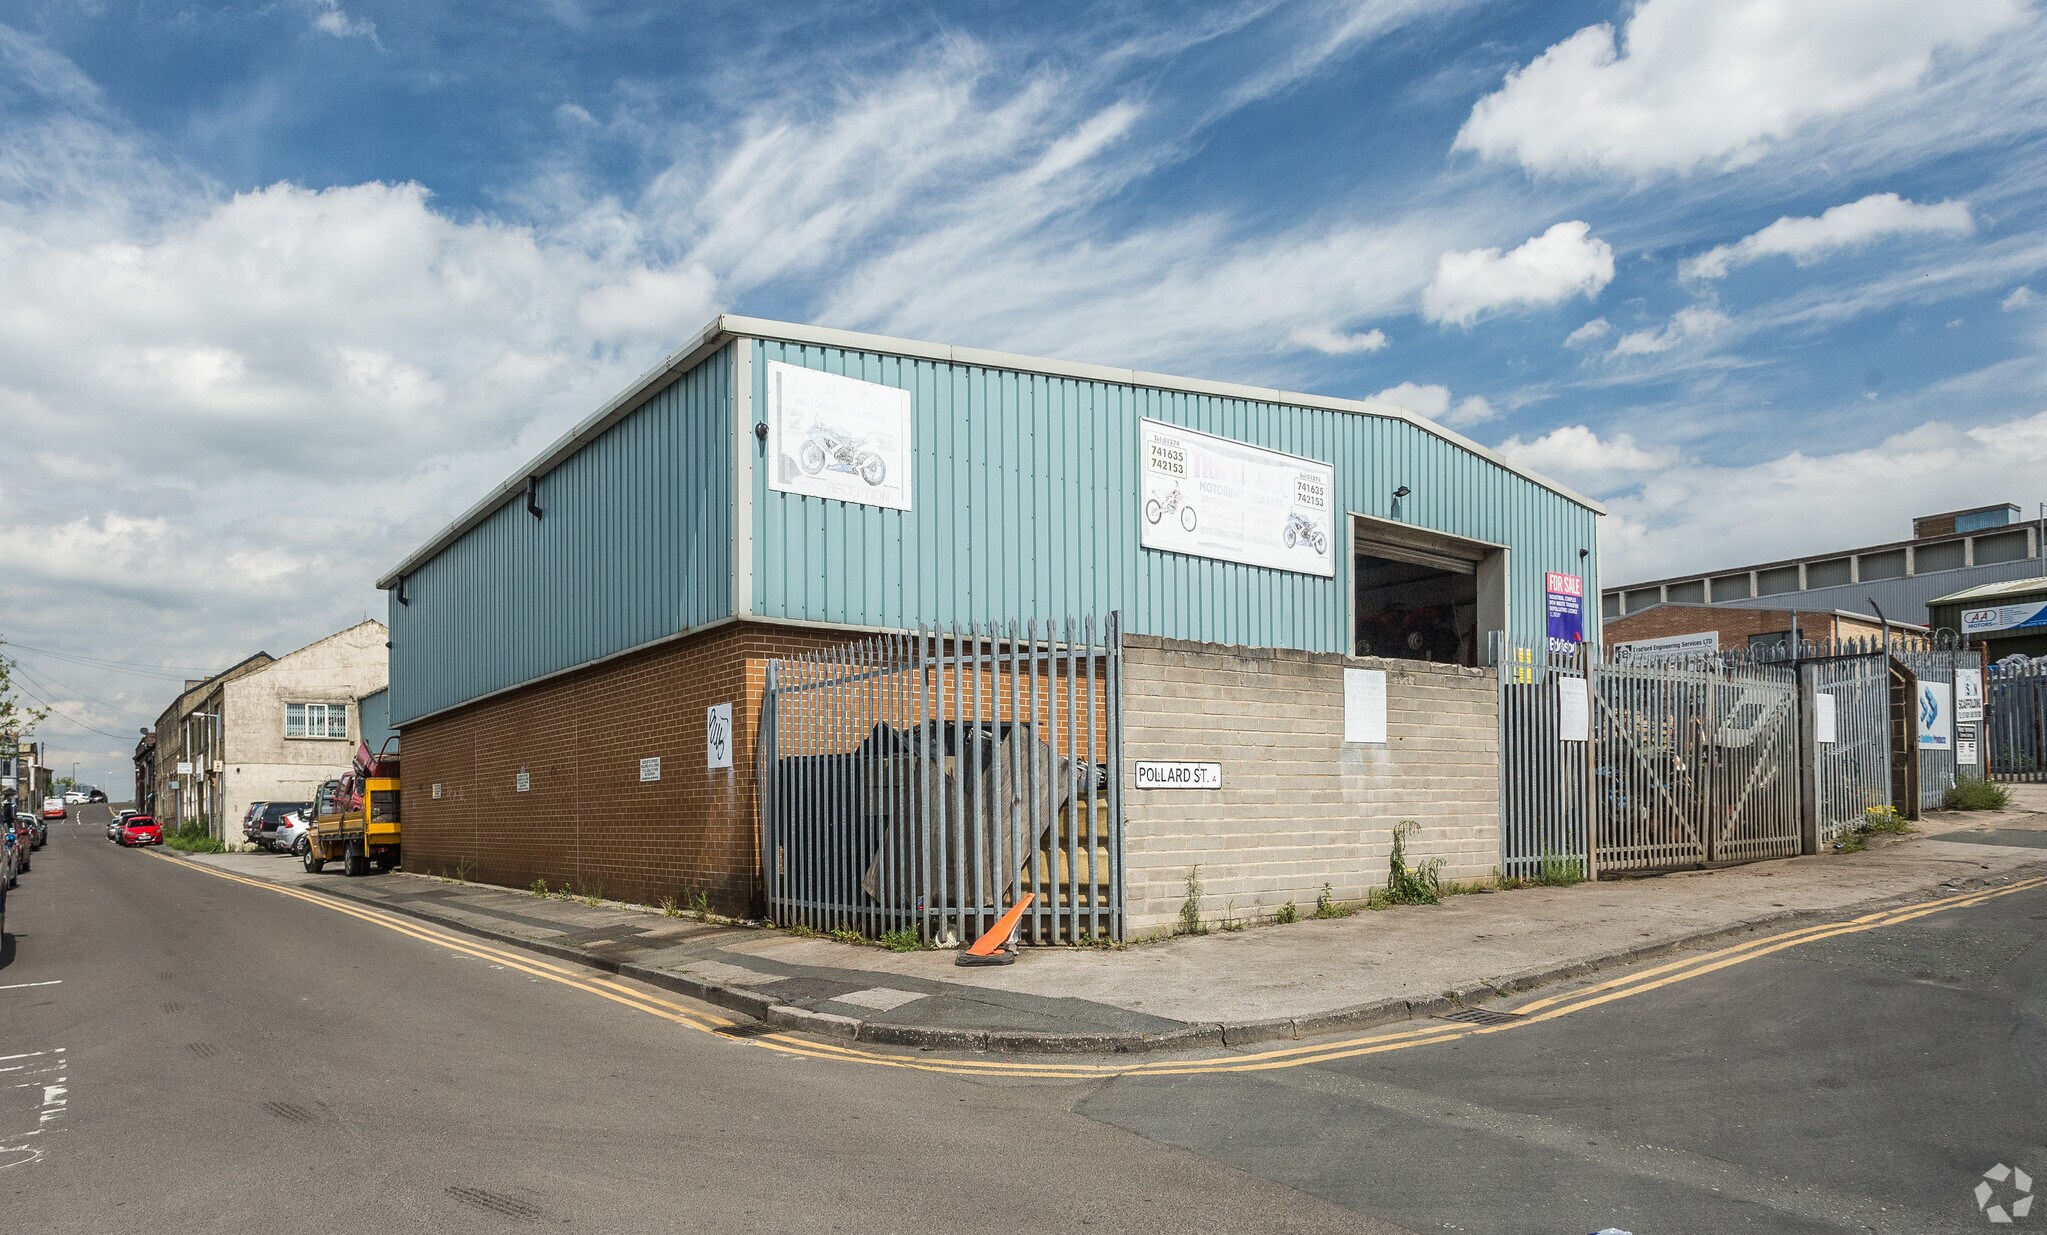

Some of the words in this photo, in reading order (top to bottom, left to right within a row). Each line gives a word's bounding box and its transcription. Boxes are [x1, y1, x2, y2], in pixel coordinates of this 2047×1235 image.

[1151, 445, 1184, 462] 741635
[1151, 458, 1184, 474] 742153
[827, 481, 890, 503] RECEPTION
[1297, 481, 1324, 496] 741635
[1297, 493, 1324, 508] 742153
[1549, 573, 1563, 592] FOR
[1564, 577, 1580, 595] SALE
[1653, 642, 1681, 651] Engineering
[1681, 640, 1702, 648] Services
[1139, 767, 1191, 783] POLLARD
[1194, 768, 1210, 783] ST.
